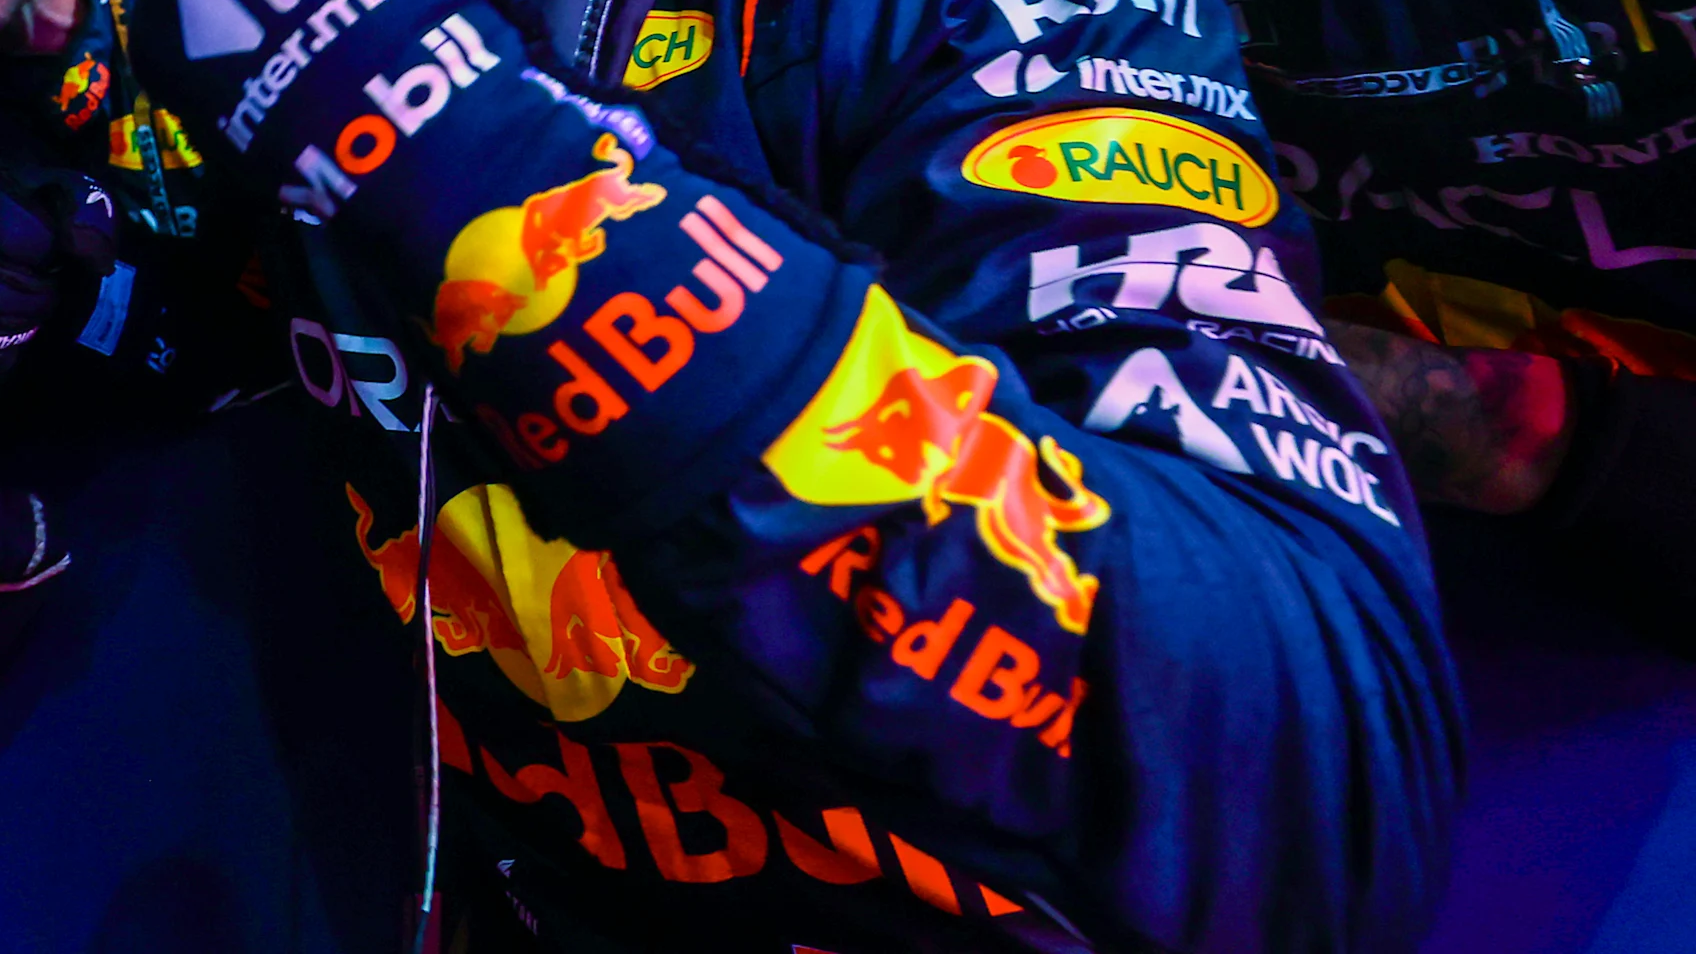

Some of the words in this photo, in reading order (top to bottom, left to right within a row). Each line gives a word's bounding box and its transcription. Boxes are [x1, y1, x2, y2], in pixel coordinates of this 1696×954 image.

[278, 13, 501, 219] Mobil
[1076, 54, 1259, 120] inter.mx
[1056, 141, 1243, 211] RAUCH
[583, 193, 784, 393] Bull
[800, 524, 974, 681] Red
